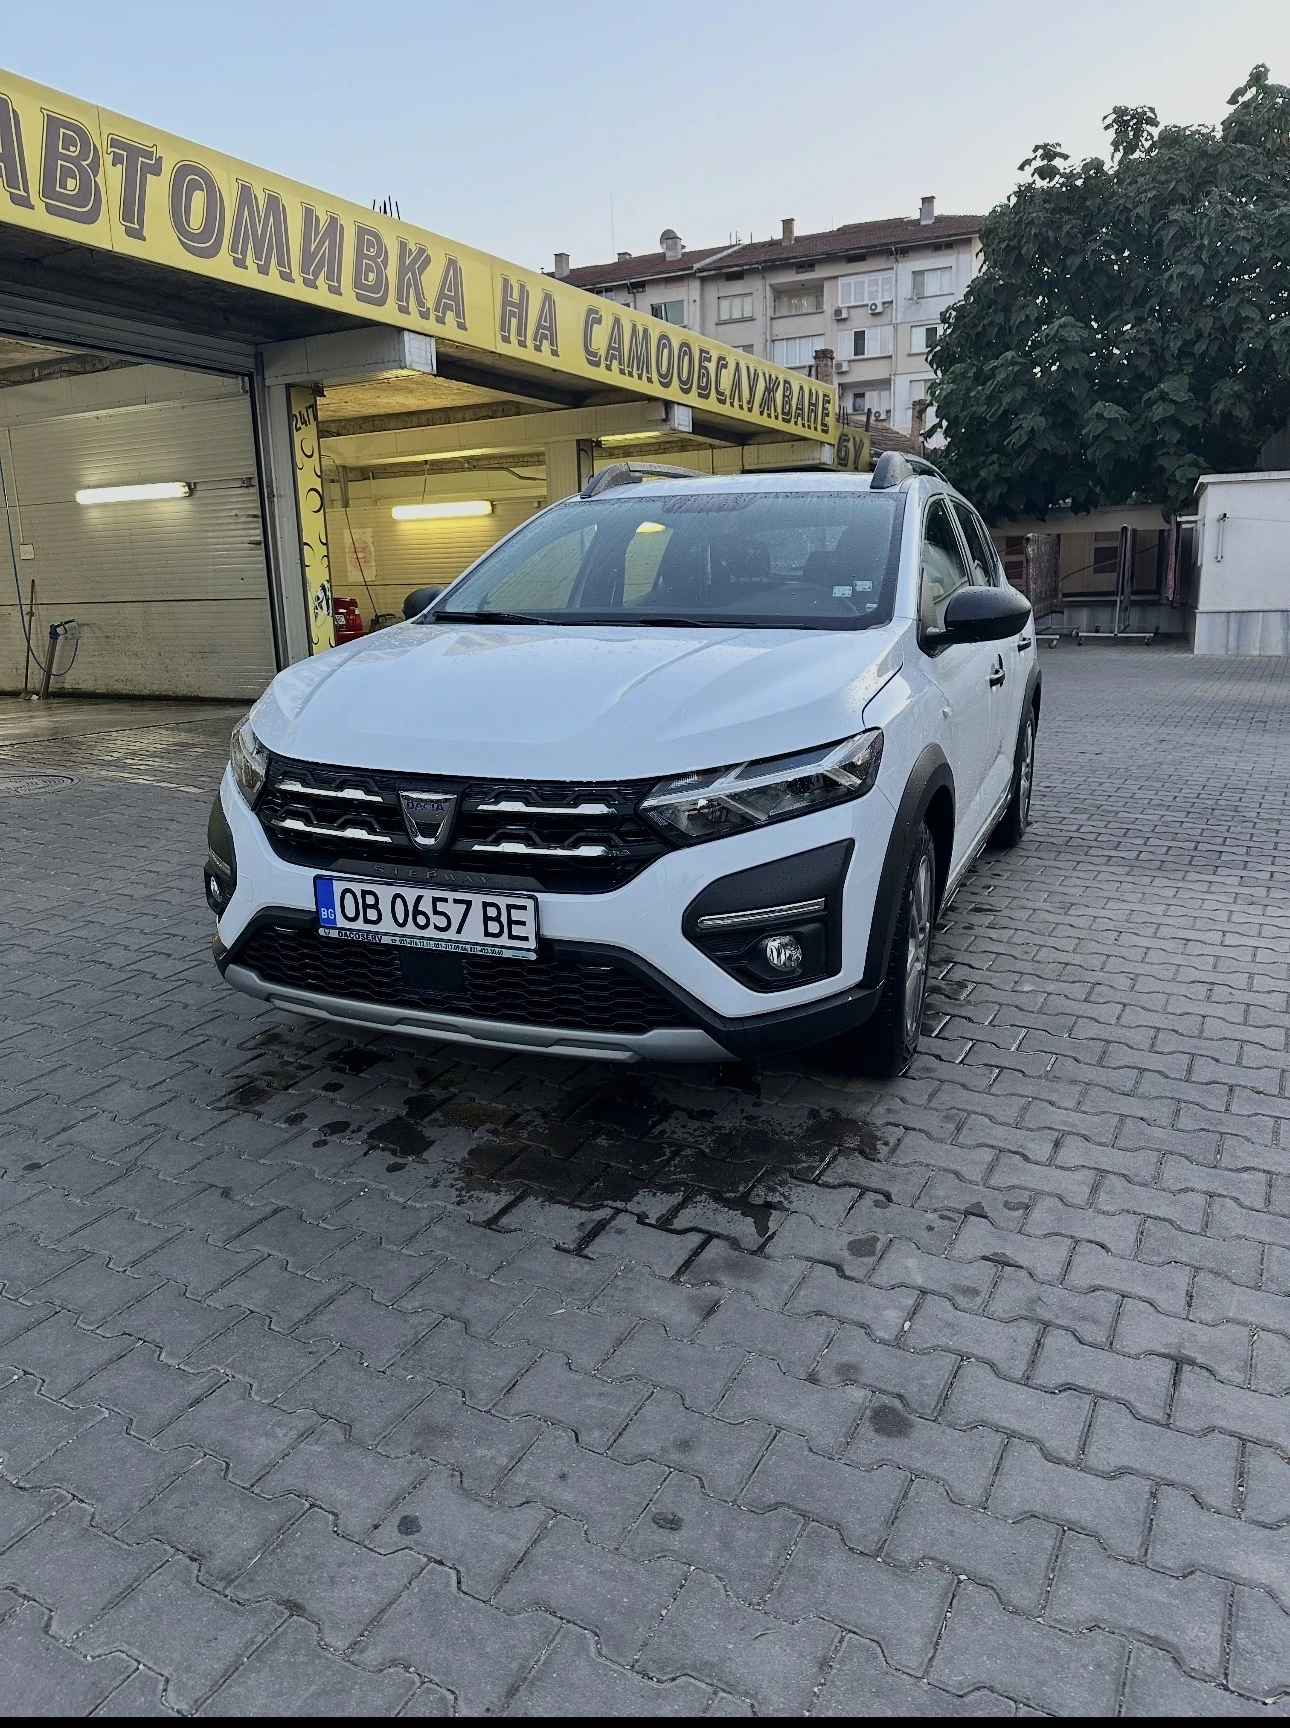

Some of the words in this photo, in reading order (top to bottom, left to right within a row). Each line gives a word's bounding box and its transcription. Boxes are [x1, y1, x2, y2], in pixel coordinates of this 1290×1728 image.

[500, 273, 560, 358] НА
[582, 304, 832, 435] САМООБСЛУЖВАНЕ
[293, 403, 316, 432] 24/7
[406, 801, 445, 812] DACIA
[374, 865, 490, 884] STEPWAY
[321, 907, 335, 920] BG
[339, 887, 383, 925] OB
[390, 892, 473, 935] 0657
[482, 900, 530, 942] BE
[337, 930, 383, 943] DACOSERV
